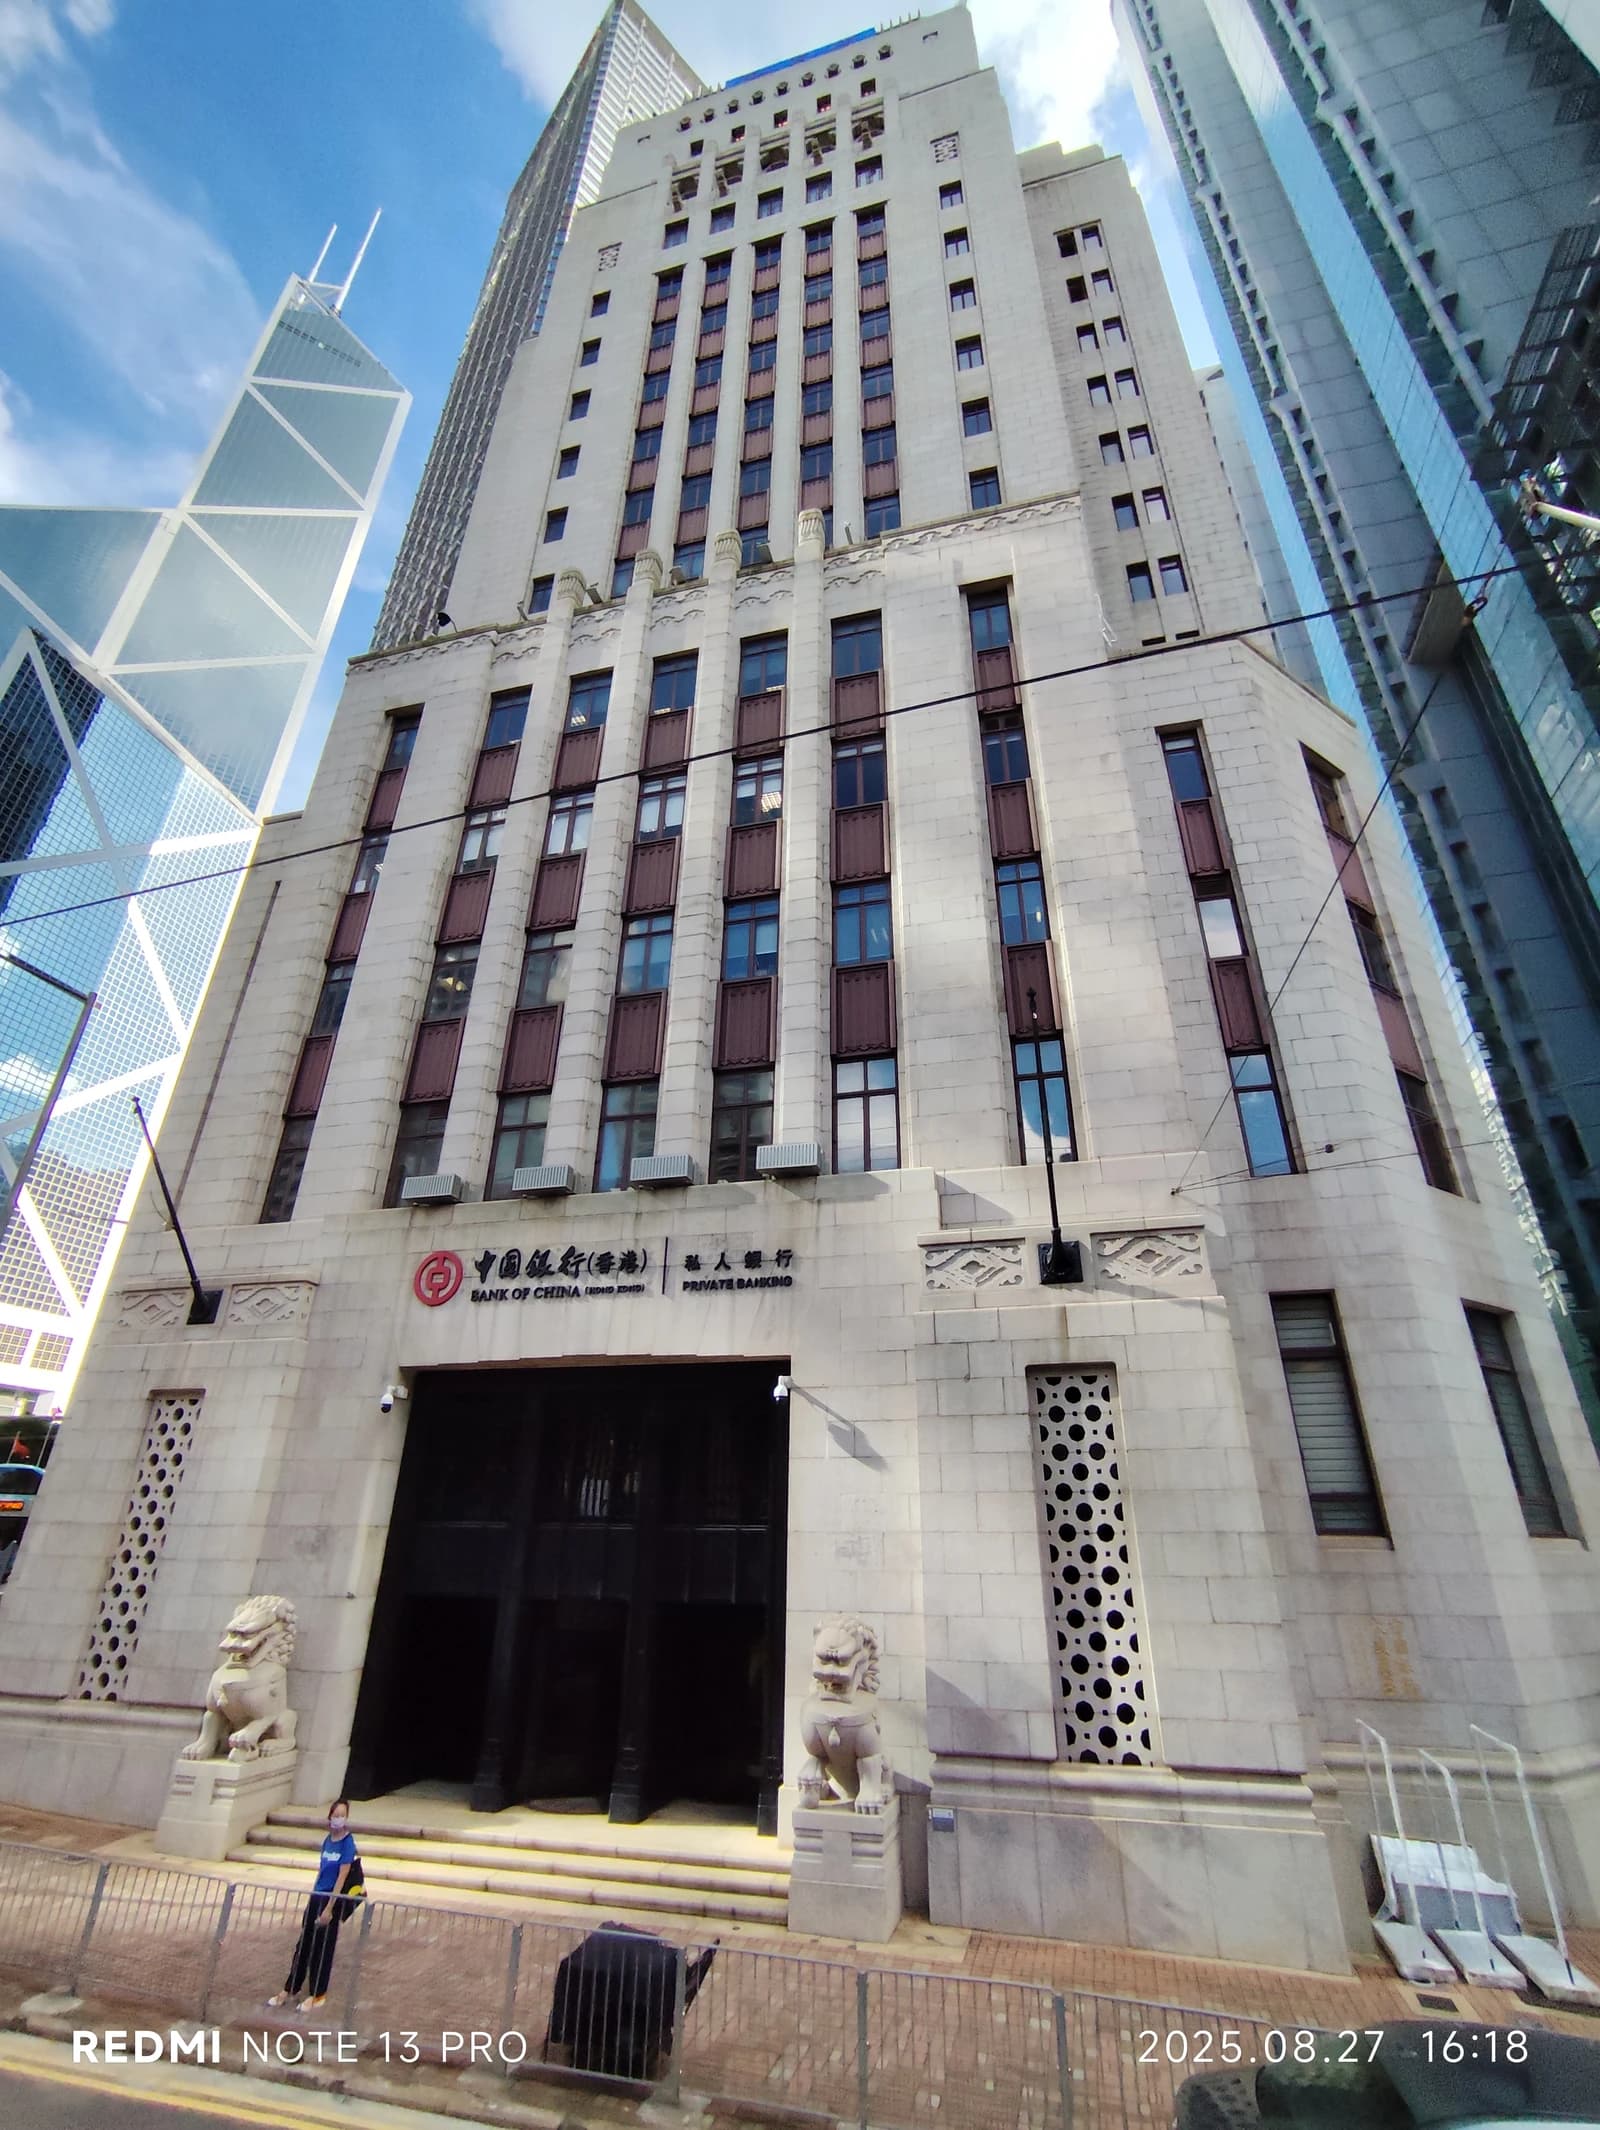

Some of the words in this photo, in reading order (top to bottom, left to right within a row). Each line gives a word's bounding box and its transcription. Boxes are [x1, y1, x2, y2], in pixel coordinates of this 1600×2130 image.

[682, 1279, 734, 1292] PRIVATE
[736, 1275, 793, 1290] BANKING
[470, 1289, 508, 1302] BANK
[511, 1287, 531, 1300] OF
[533, 1285, 581, 1299] CHINA
